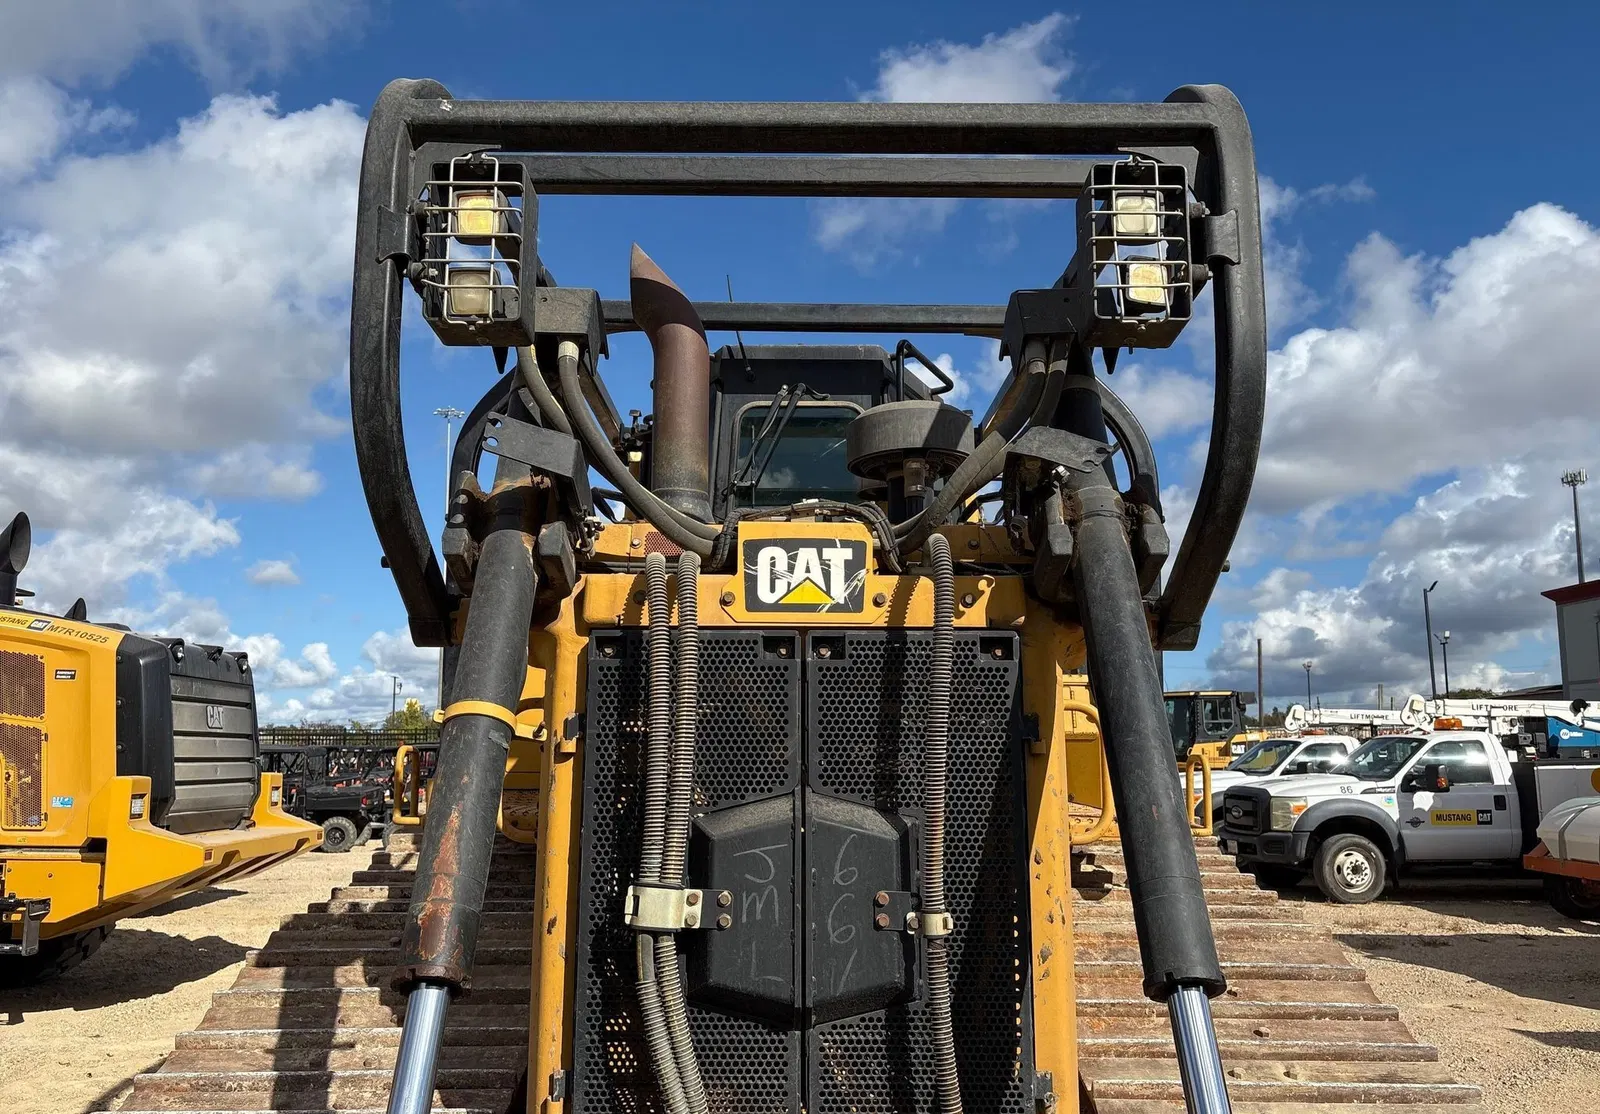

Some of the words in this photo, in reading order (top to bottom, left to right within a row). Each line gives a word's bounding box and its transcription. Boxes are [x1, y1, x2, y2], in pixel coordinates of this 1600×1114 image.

[757, 546, 853, 604] CAT
[47, 624, 109, 644] M7R10525
[206, 705, 224, 729] CAT
[1231, 744, 1246, 754] CAT
[1340, 786, 1353, 794] 86
[1435, 813, 1472, 822] MUSTANG
[1478, 812, 1491, 821] CAT
